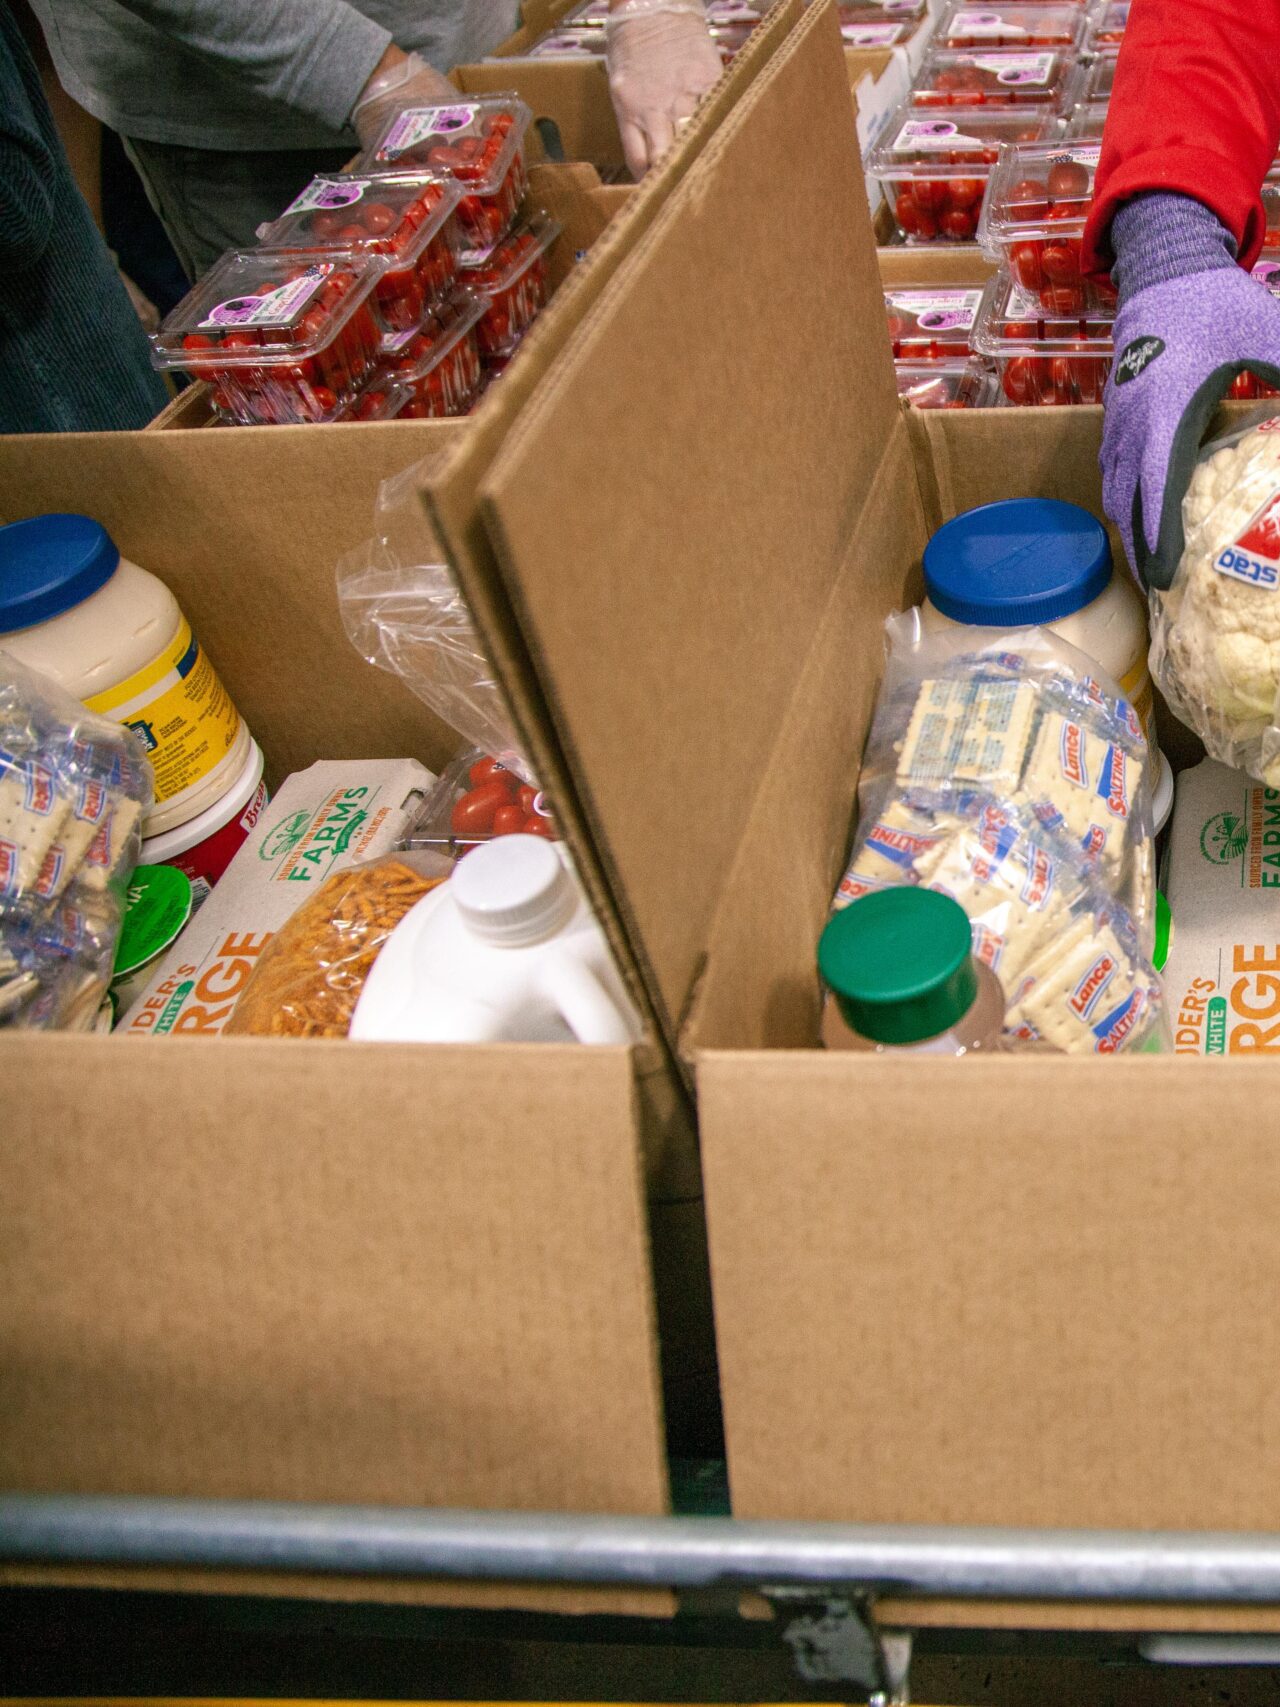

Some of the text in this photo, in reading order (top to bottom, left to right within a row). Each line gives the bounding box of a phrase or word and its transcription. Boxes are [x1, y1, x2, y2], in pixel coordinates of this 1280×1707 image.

[1217, 548, 1279, 584] stag
[1064, 724, 1081, 784] Lance
[288, 786, 369, 881] FARMS
[1251, 811, 1263, 835] FAMILY
[1251, 836, 1262, 854] FROM
[1249, 855, 1261, 889] SOURCED
[127, 964, 197, 1035] DER'S
[172, 932, 276, 1035] RGE
[1070, 957, 1113, 1013] Lance
